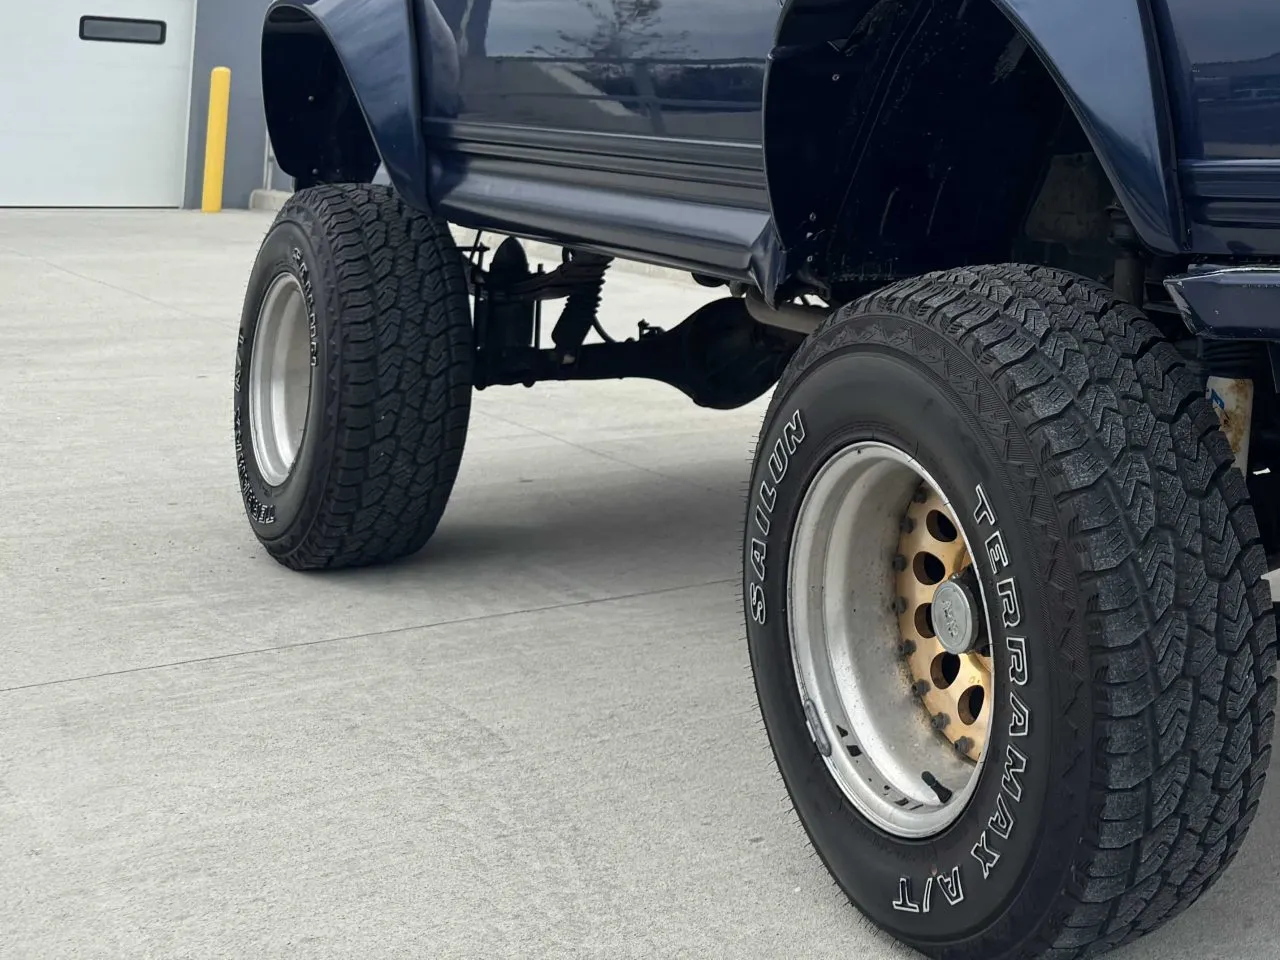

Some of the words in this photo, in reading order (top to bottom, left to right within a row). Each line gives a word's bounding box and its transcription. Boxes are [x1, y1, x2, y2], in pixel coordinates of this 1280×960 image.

[750, 409, 806, 624] SAILUN
[970, 483, 1029, 880] TERRAMAX
[892, 865, 964, 913] A/T
